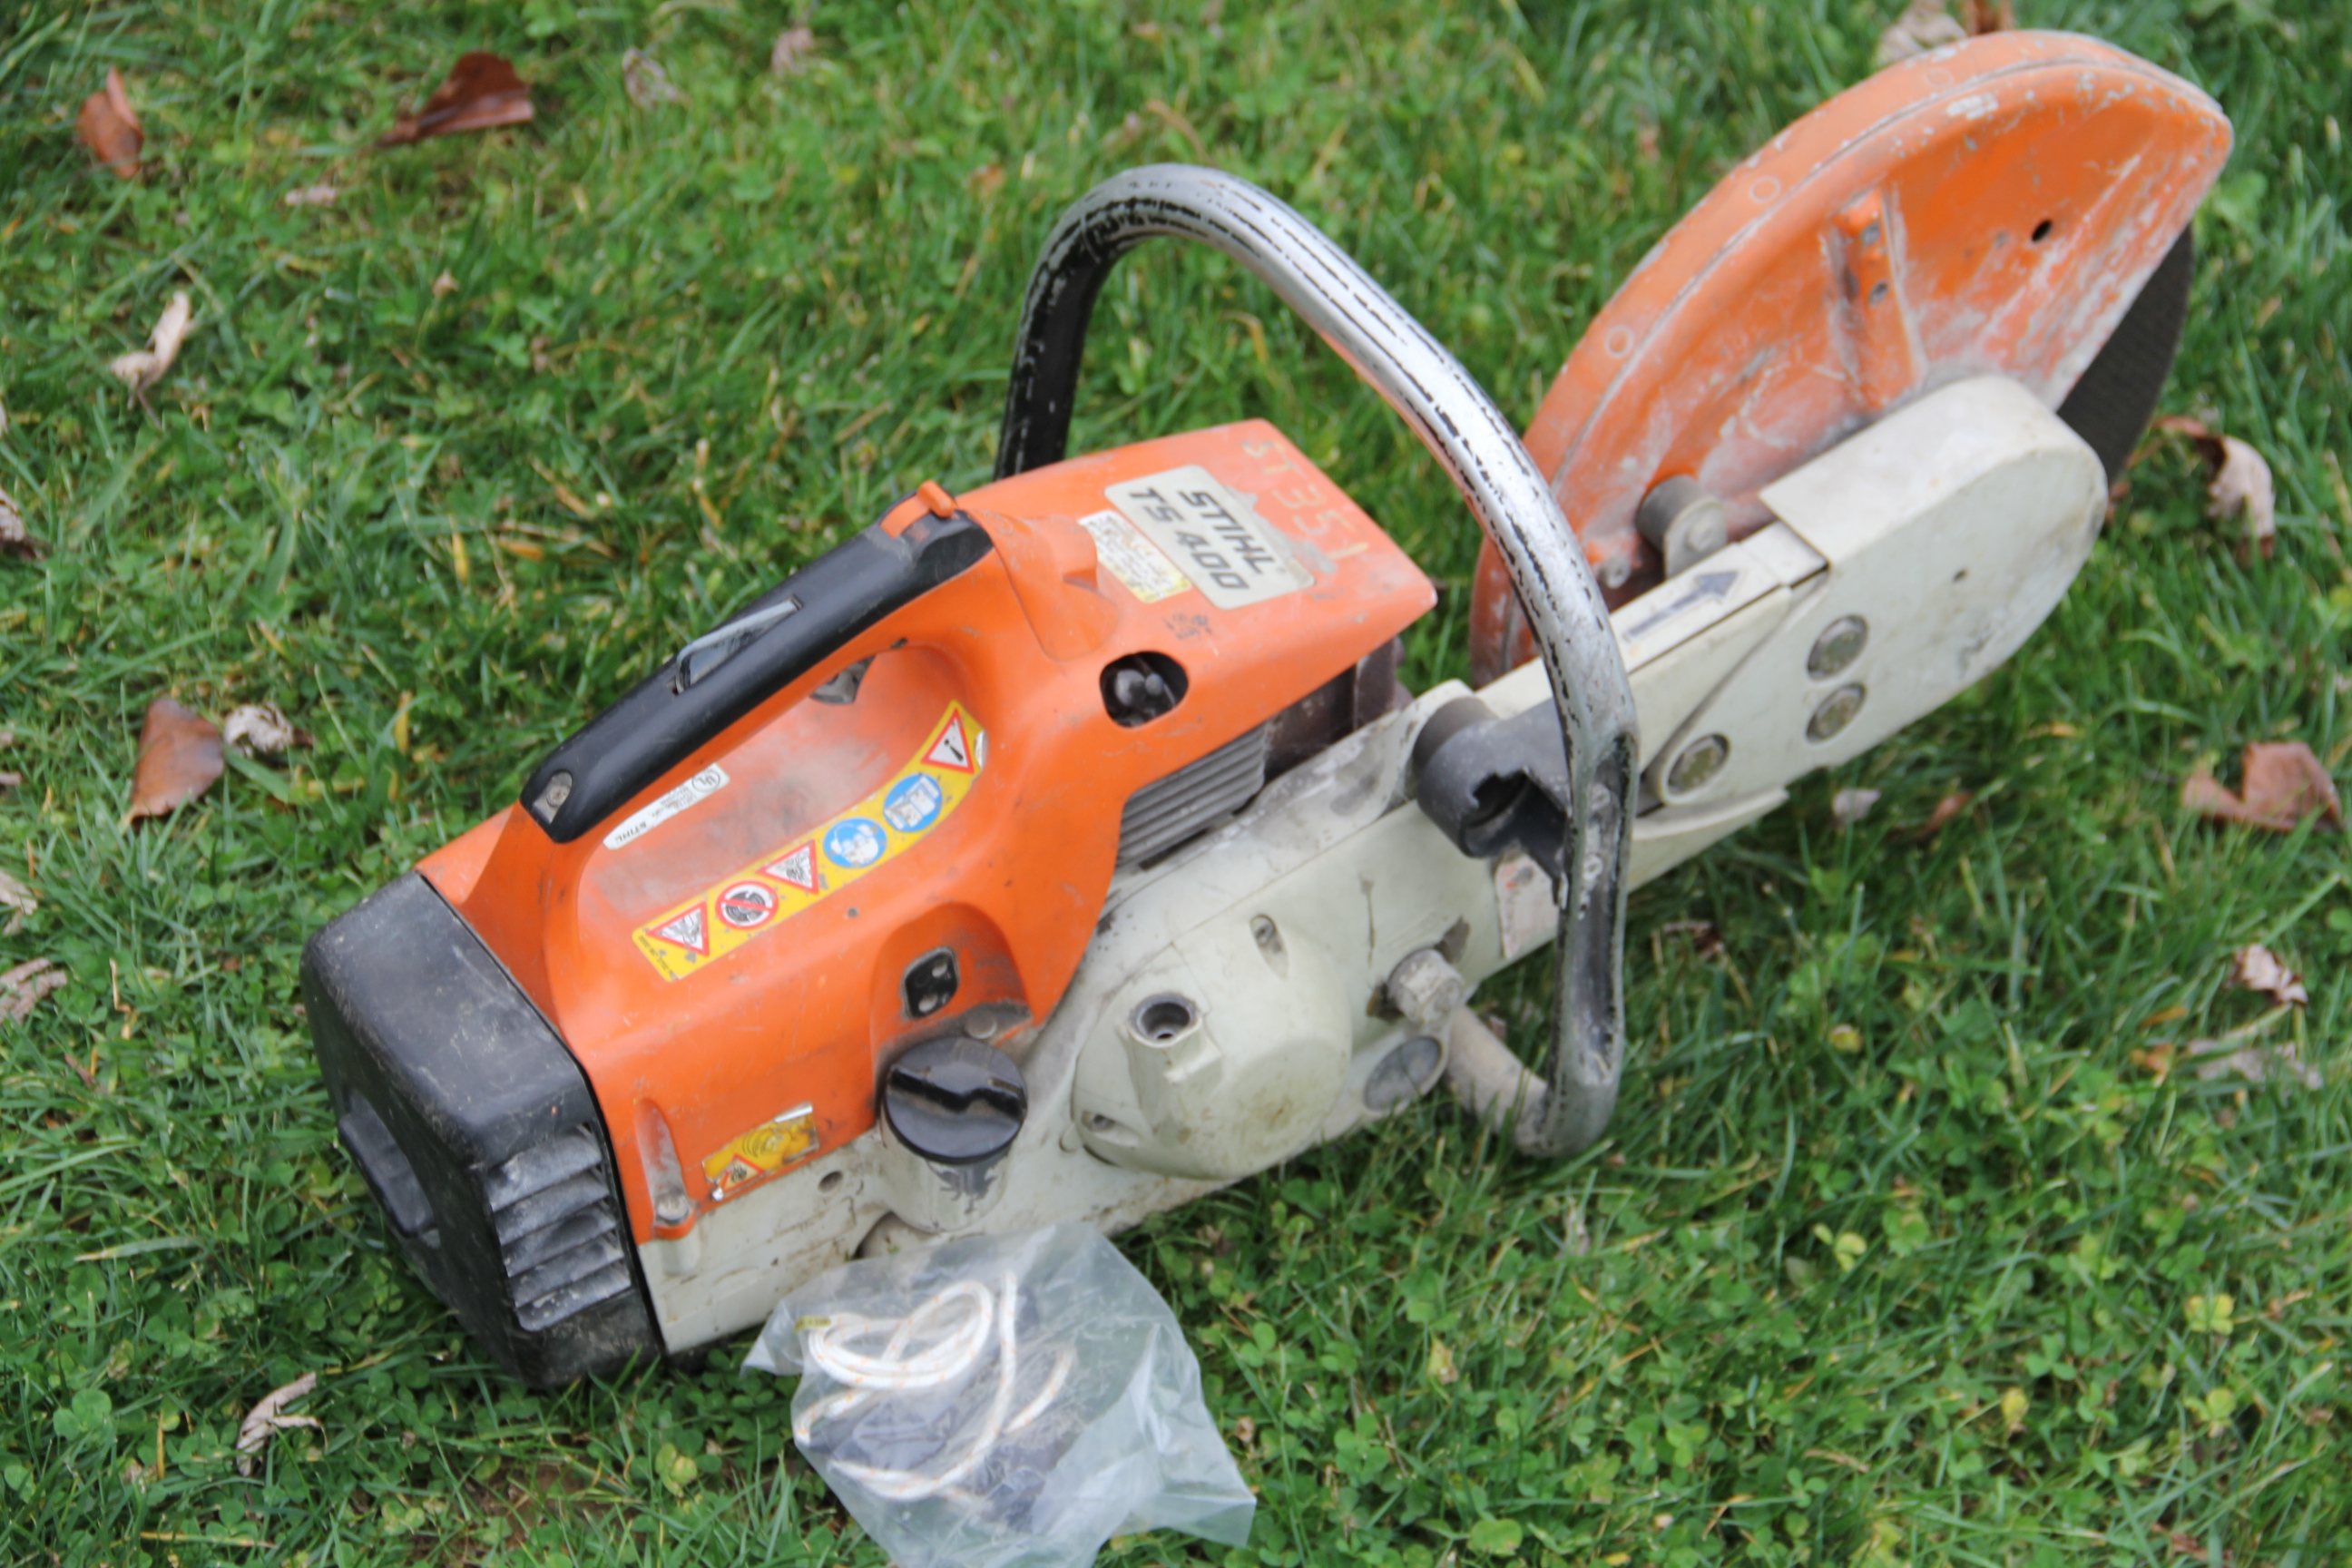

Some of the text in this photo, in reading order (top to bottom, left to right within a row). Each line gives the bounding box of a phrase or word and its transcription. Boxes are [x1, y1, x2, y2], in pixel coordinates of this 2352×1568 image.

[1128, 486, 1187, 524] TS
[1174, 530, 1250, 590] 400
[1178, 490, 1276, 574] STIHL
